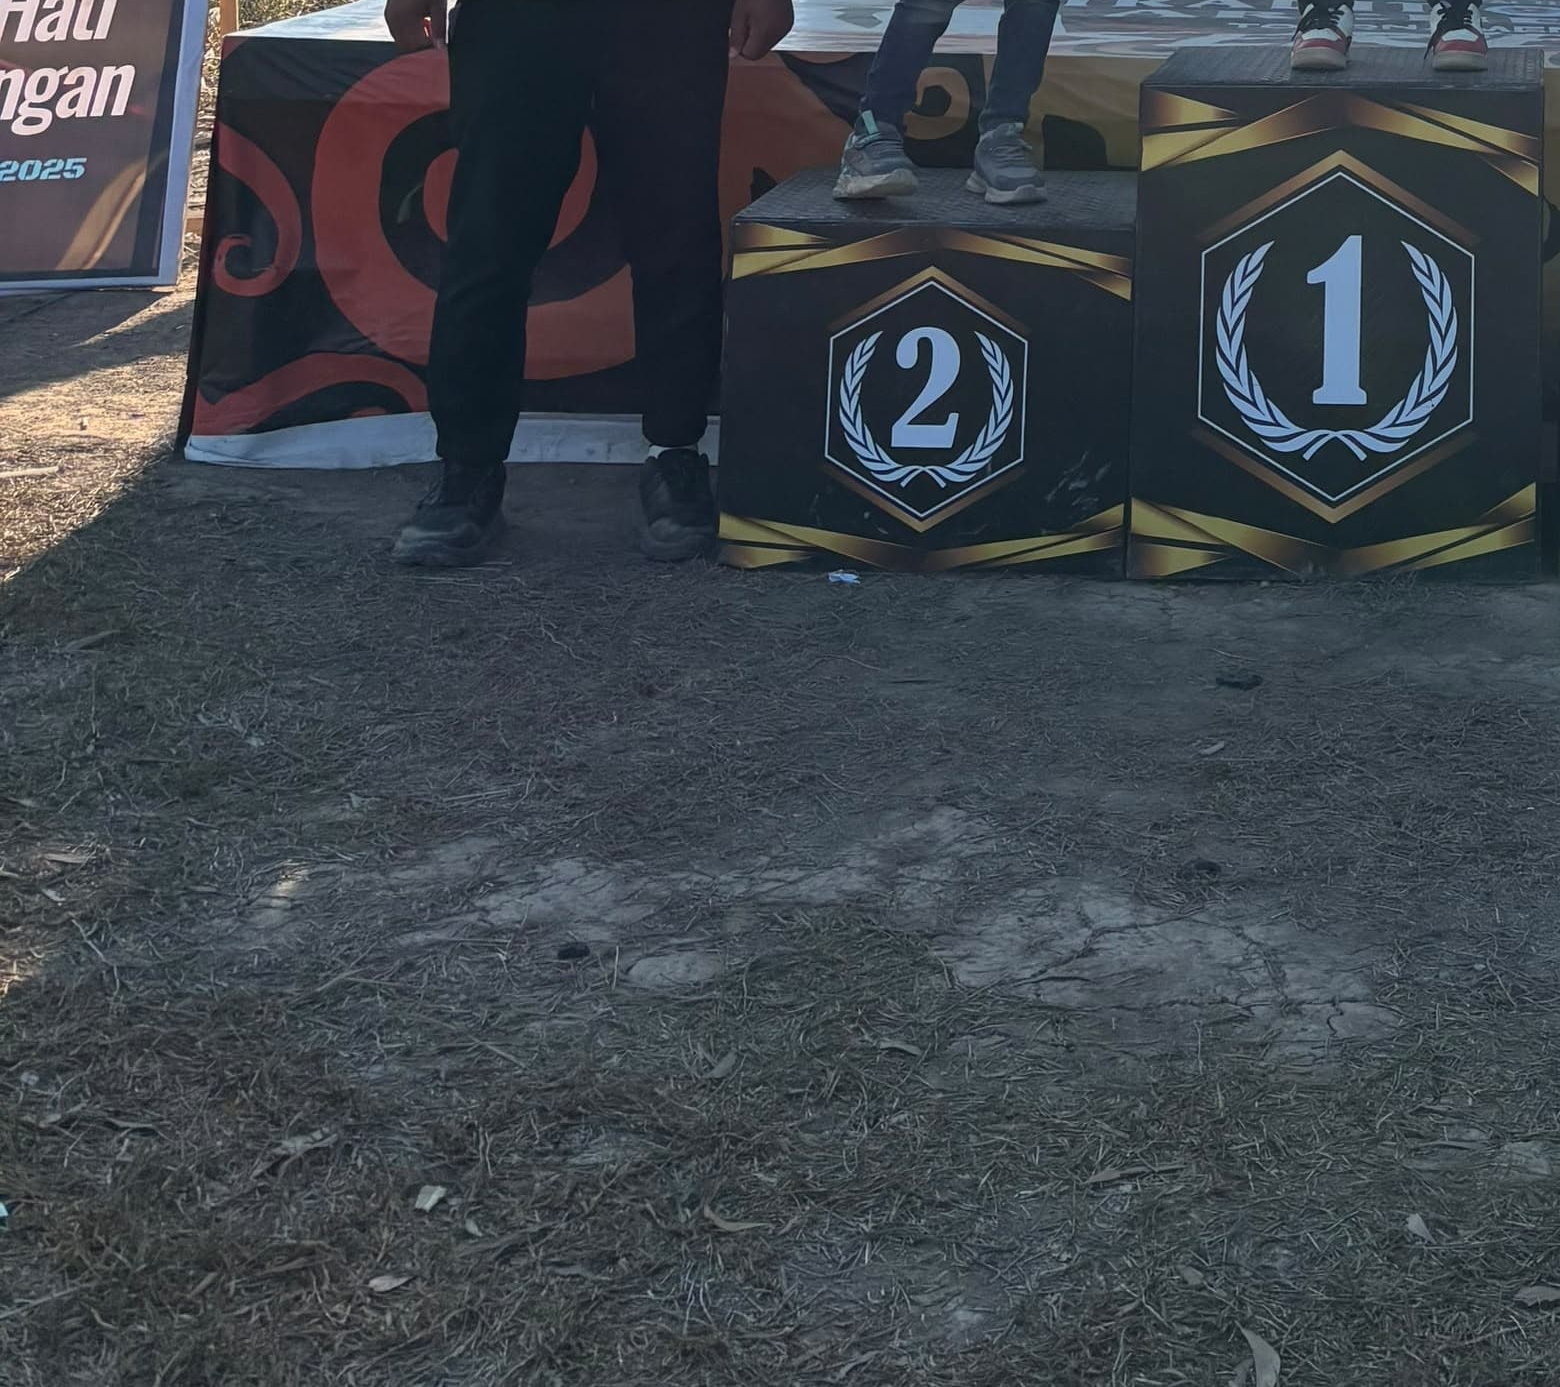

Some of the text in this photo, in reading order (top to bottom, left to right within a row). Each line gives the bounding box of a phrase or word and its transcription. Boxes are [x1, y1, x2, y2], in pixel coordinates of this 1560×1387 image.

[0, 157, 88, 182] 2025
[1306, 234, 1368, 406] 1
[890, 325, 961, 450] 2
